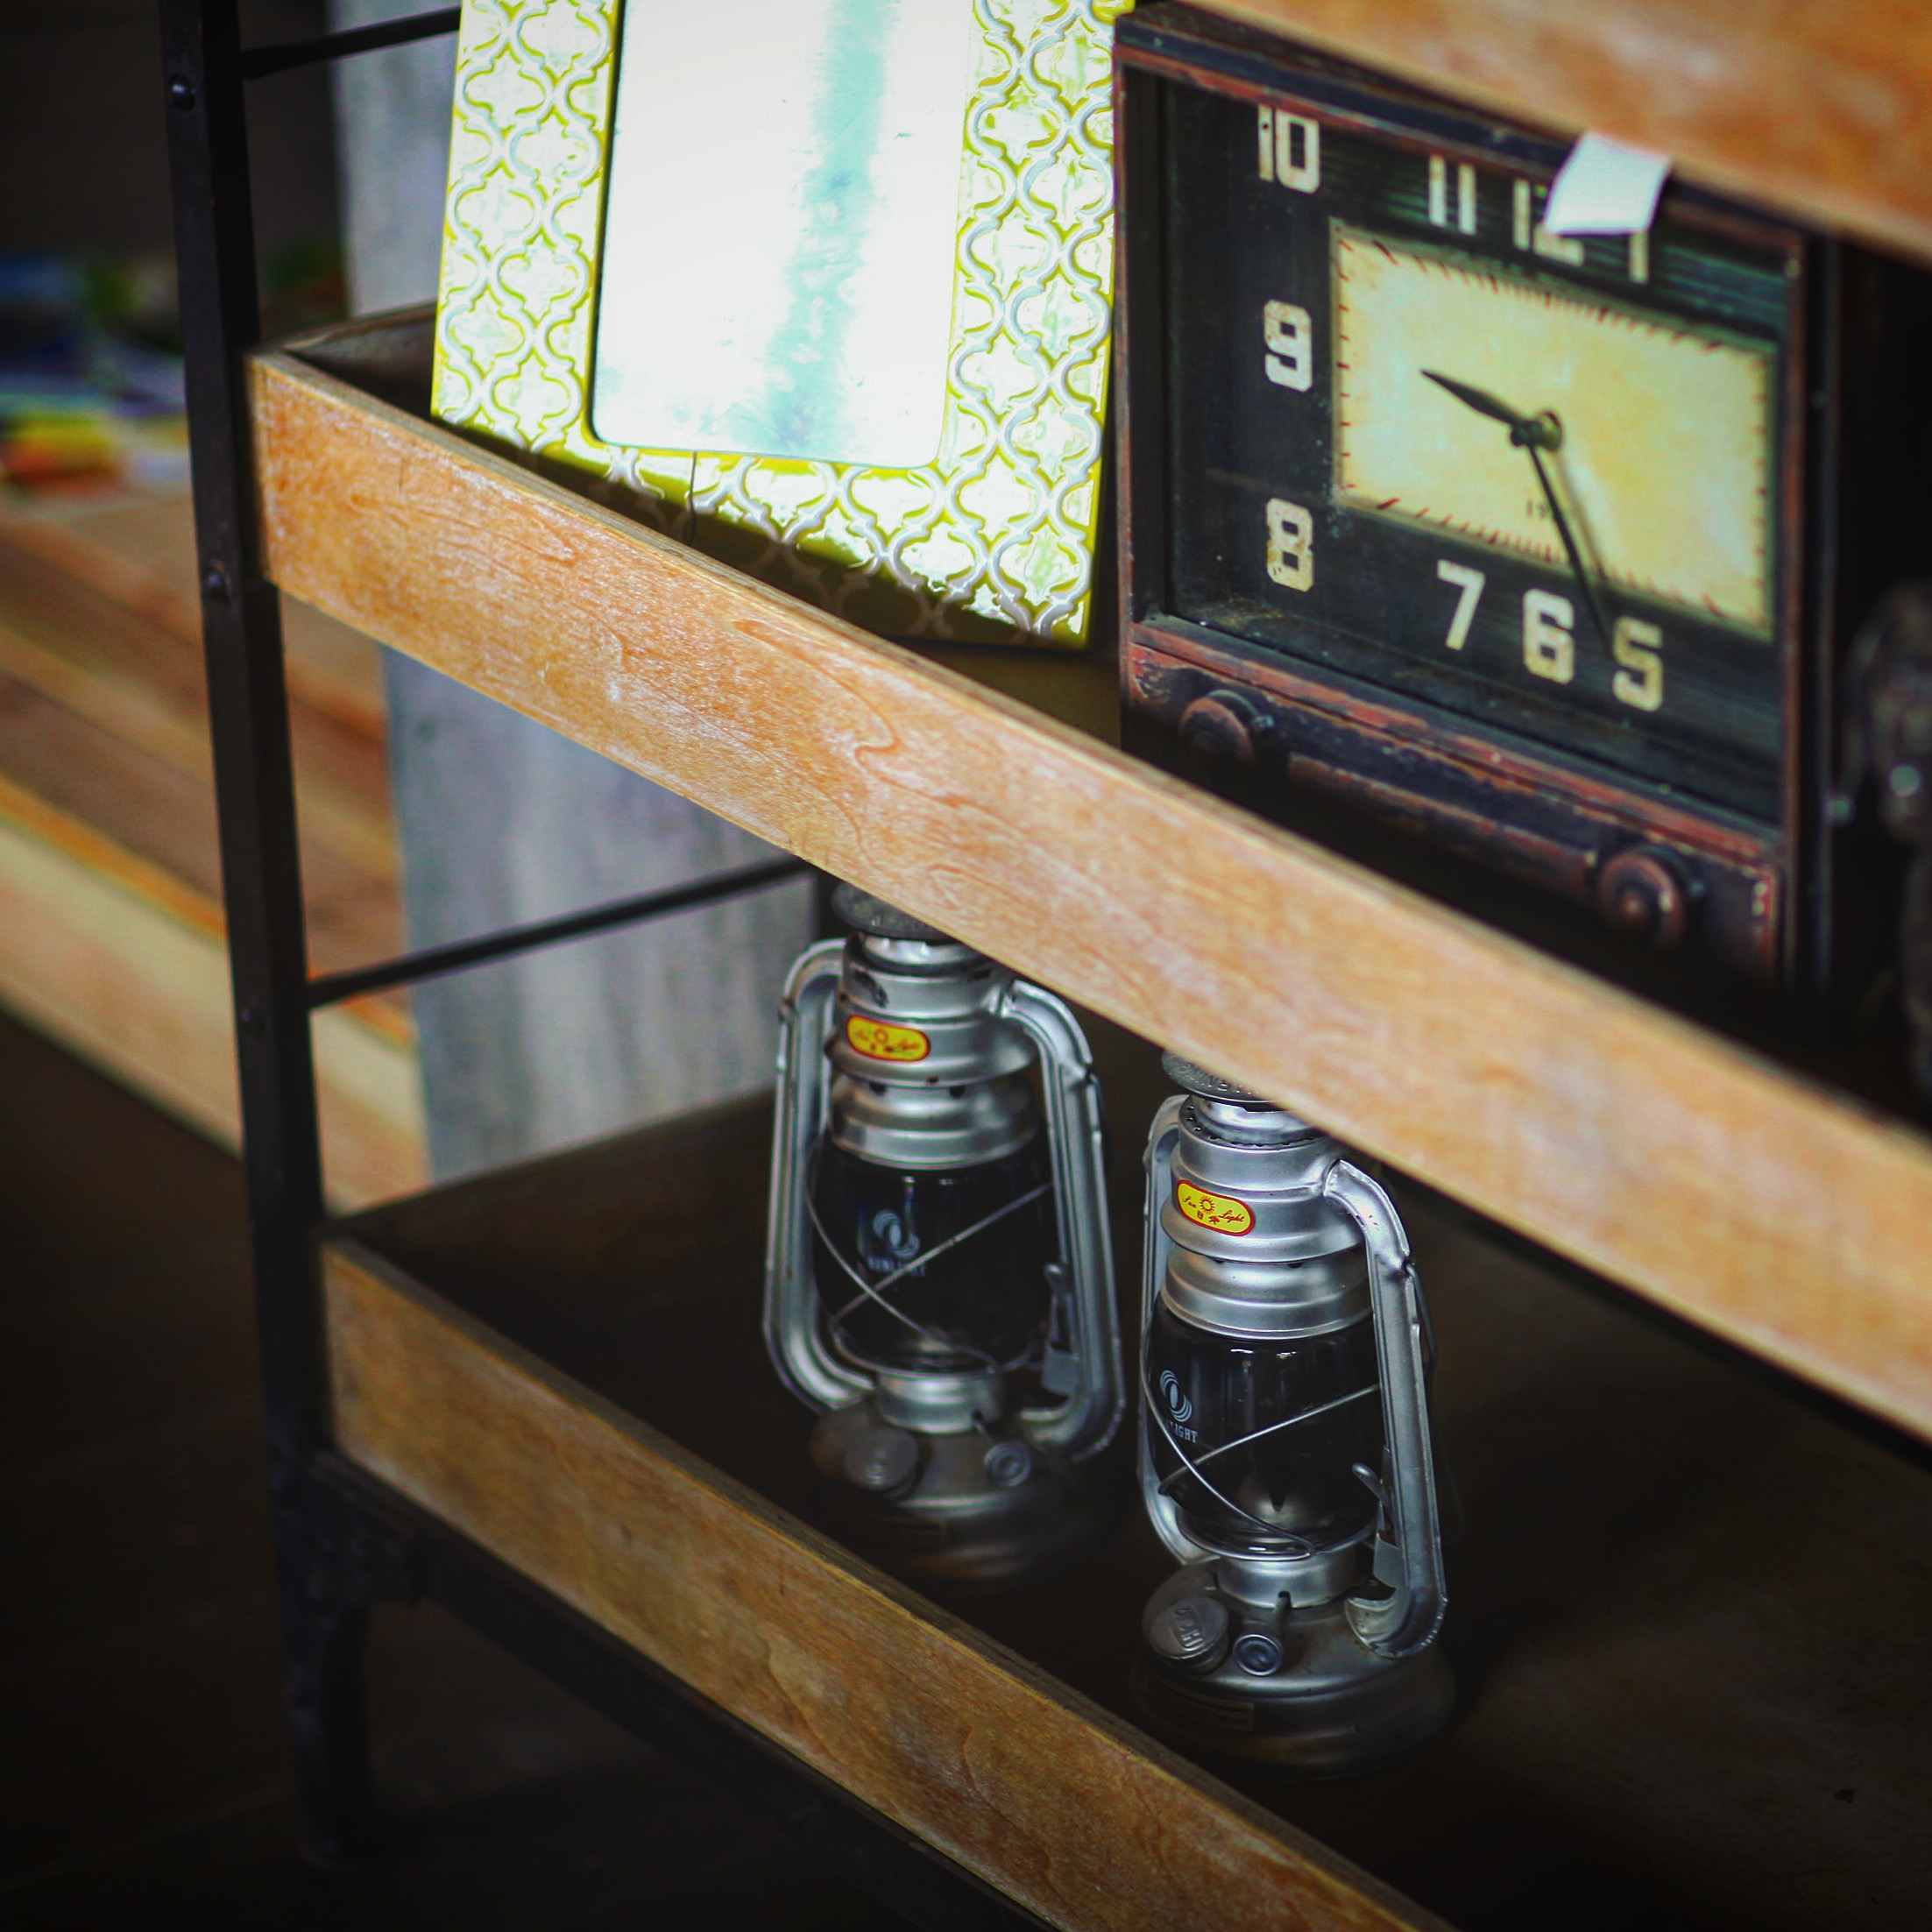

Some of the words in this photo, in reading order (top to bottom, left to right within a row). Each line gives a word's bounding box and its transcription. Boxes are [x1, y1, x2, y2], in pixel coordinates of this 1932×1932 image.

[1257, 103, 1320, 193] 10
[1427, 155, 1477, 236] 11
[1263, 299, 1313, 393] 9
[1265, 498, 1314, 592] 8
[1437, 559, 1485, 651] 7
[1522, 588, 1575, 684] 6
[1611, 617, 1663, 711] 5
[1170, 1421, 1199, 1444] IGHT
